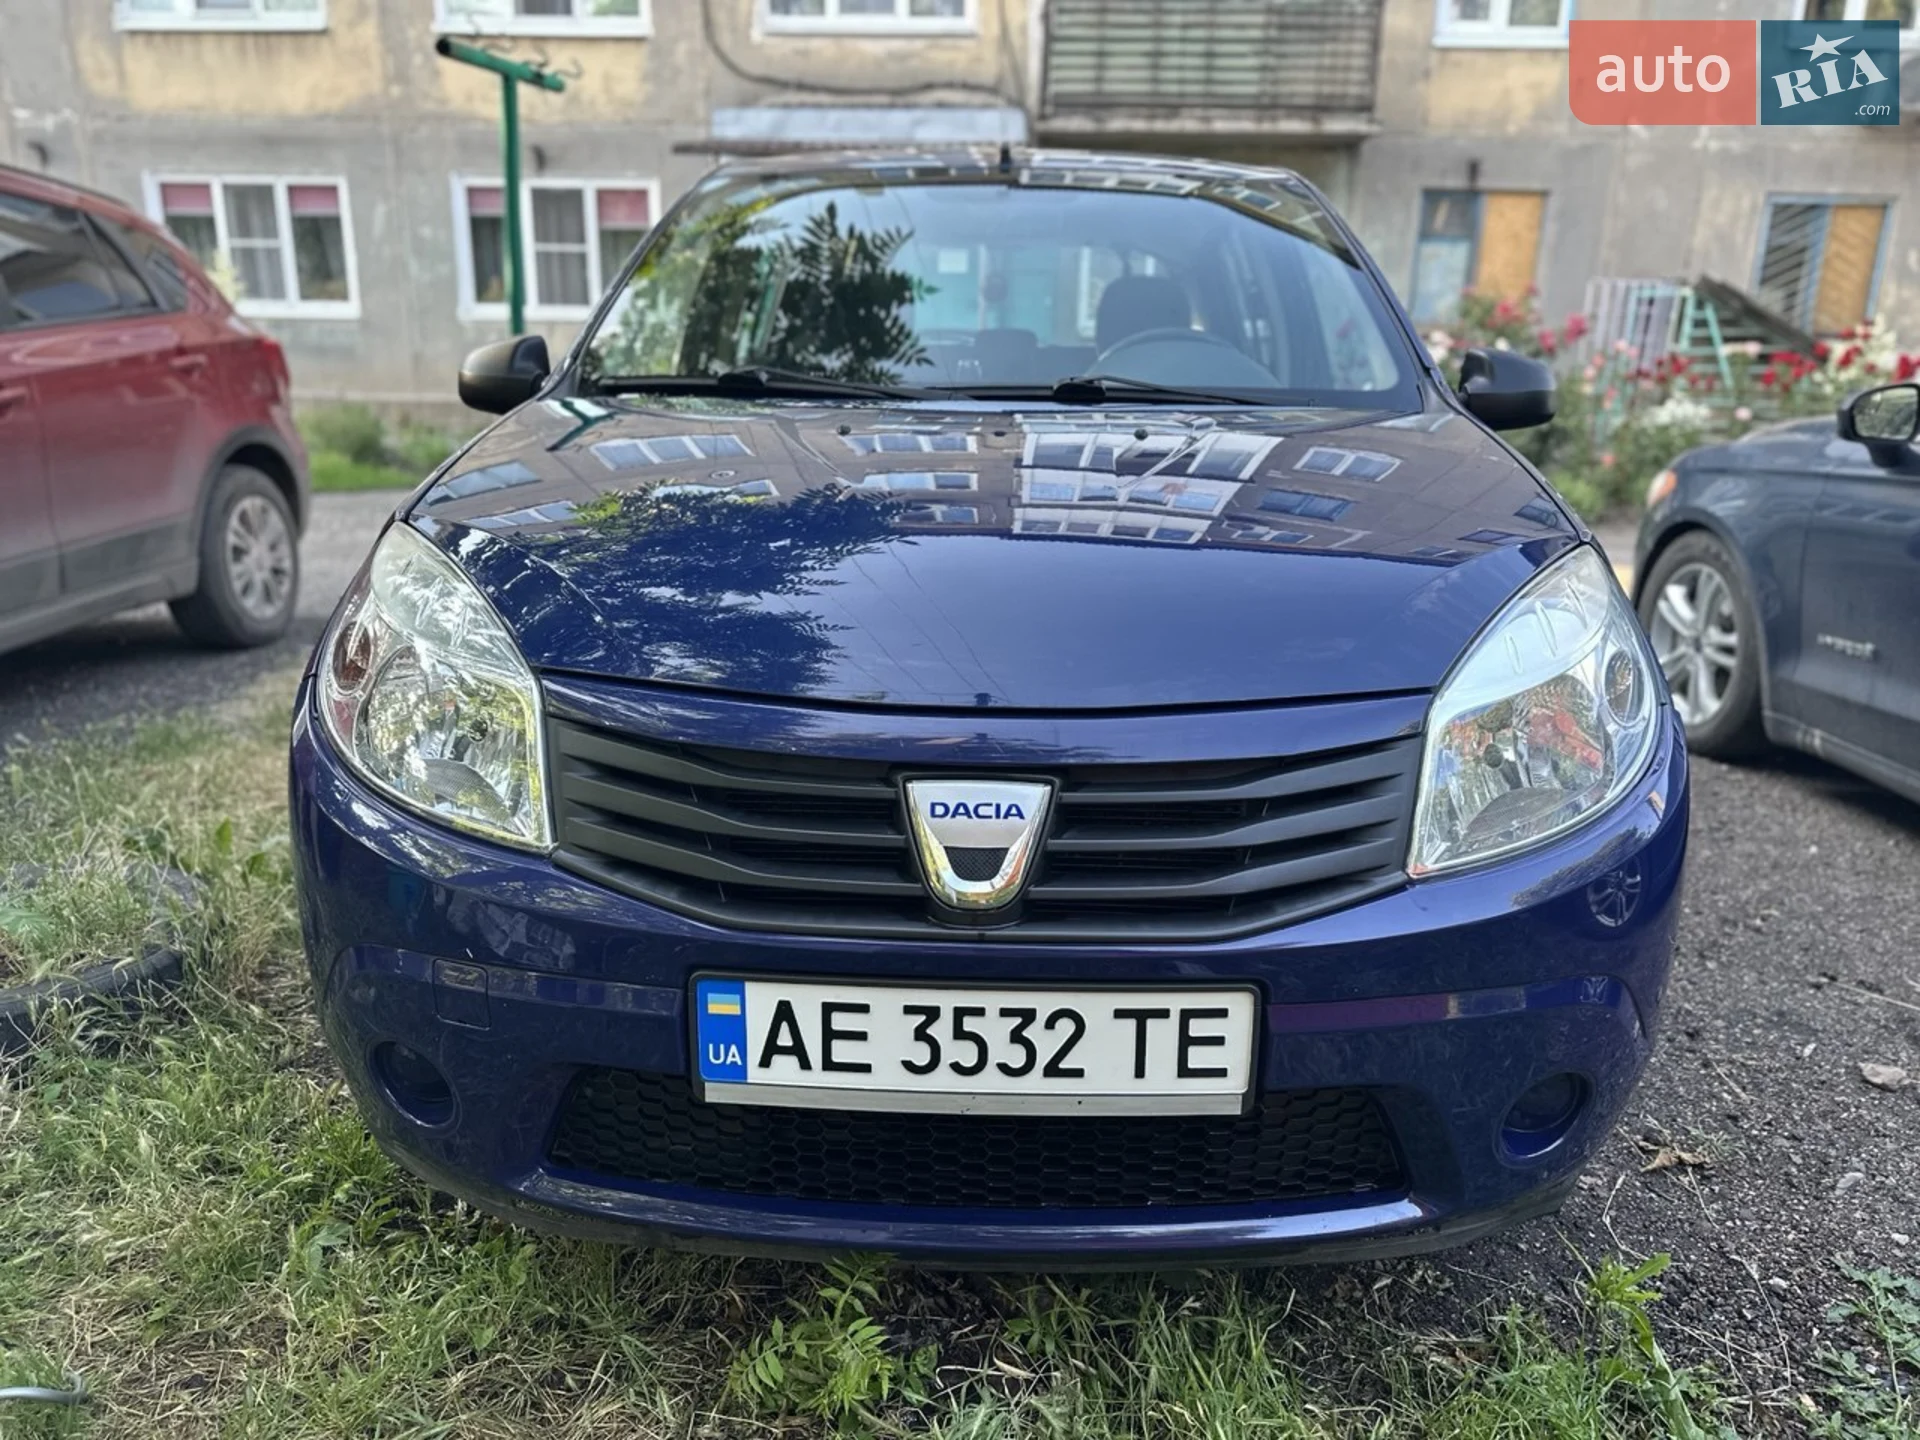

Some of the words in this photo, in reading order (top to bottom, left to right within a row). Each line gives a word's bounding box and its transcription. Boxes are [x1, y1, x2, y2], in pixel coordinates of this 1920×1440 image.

[930, 801, 1026, 820] DACIA
[758, 999, 873, 1074] AE
[900, 1004, 1087, 1079] 3532
[1113, 1007, 1229, 1079] TE
[707, 1042, 743, 1067] UA
